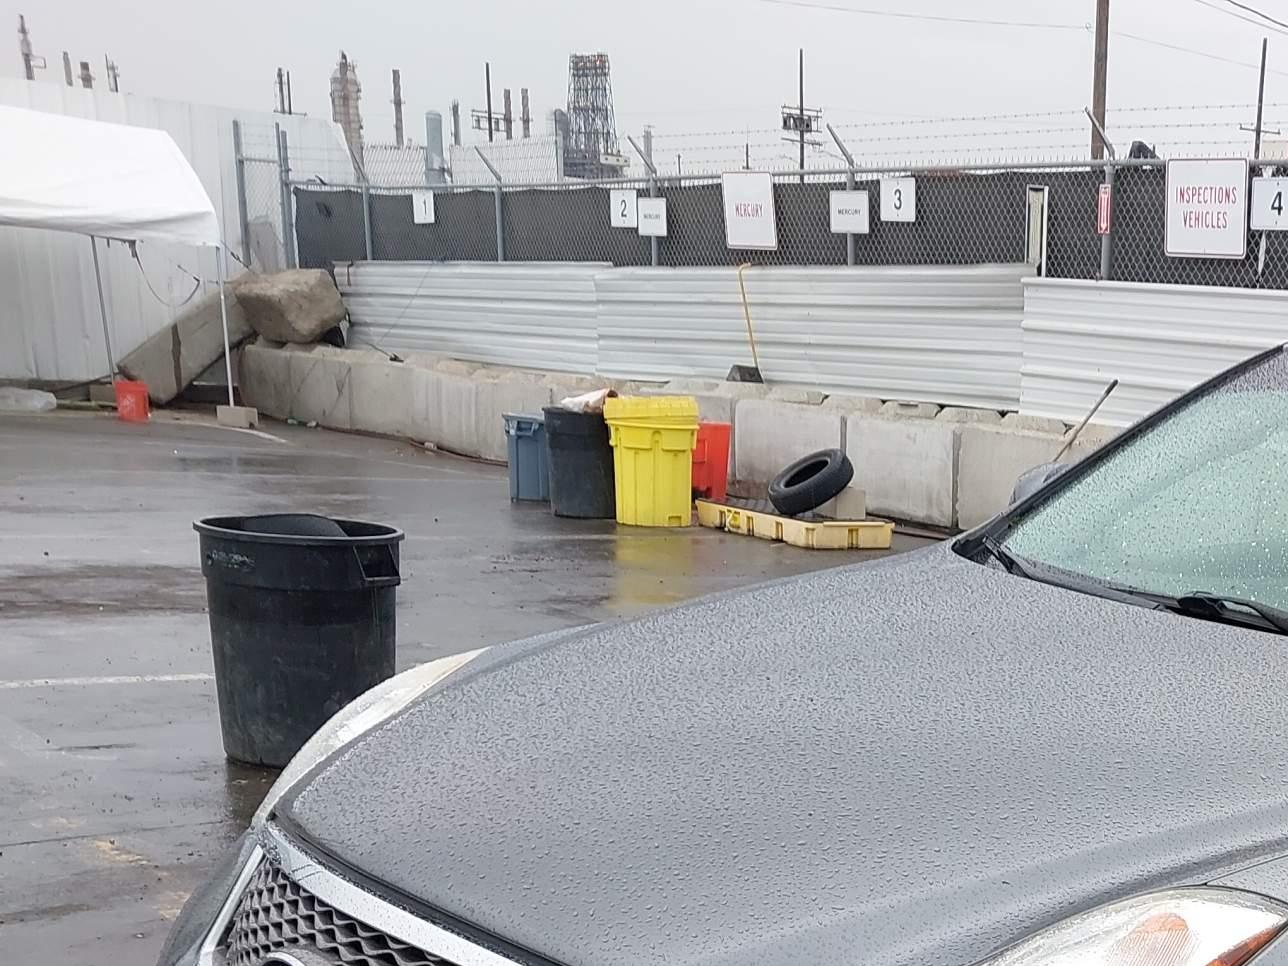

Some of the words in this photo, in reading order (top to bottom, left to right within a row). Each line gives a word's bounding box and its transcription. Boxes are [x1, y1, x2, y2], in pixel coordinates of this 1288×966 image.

[893, 188, 902, 210] 3
[1176, 186, 1237, 205] INSPECTIONS
[1270, 191, 1283, 216] 4
[620, 200, 628, 218] 2
[735, 203, 763, 218] MERCURY
[838, 208, 861, 216] MERCURY
[1183, 210, 1228, 229] VEHICLES
